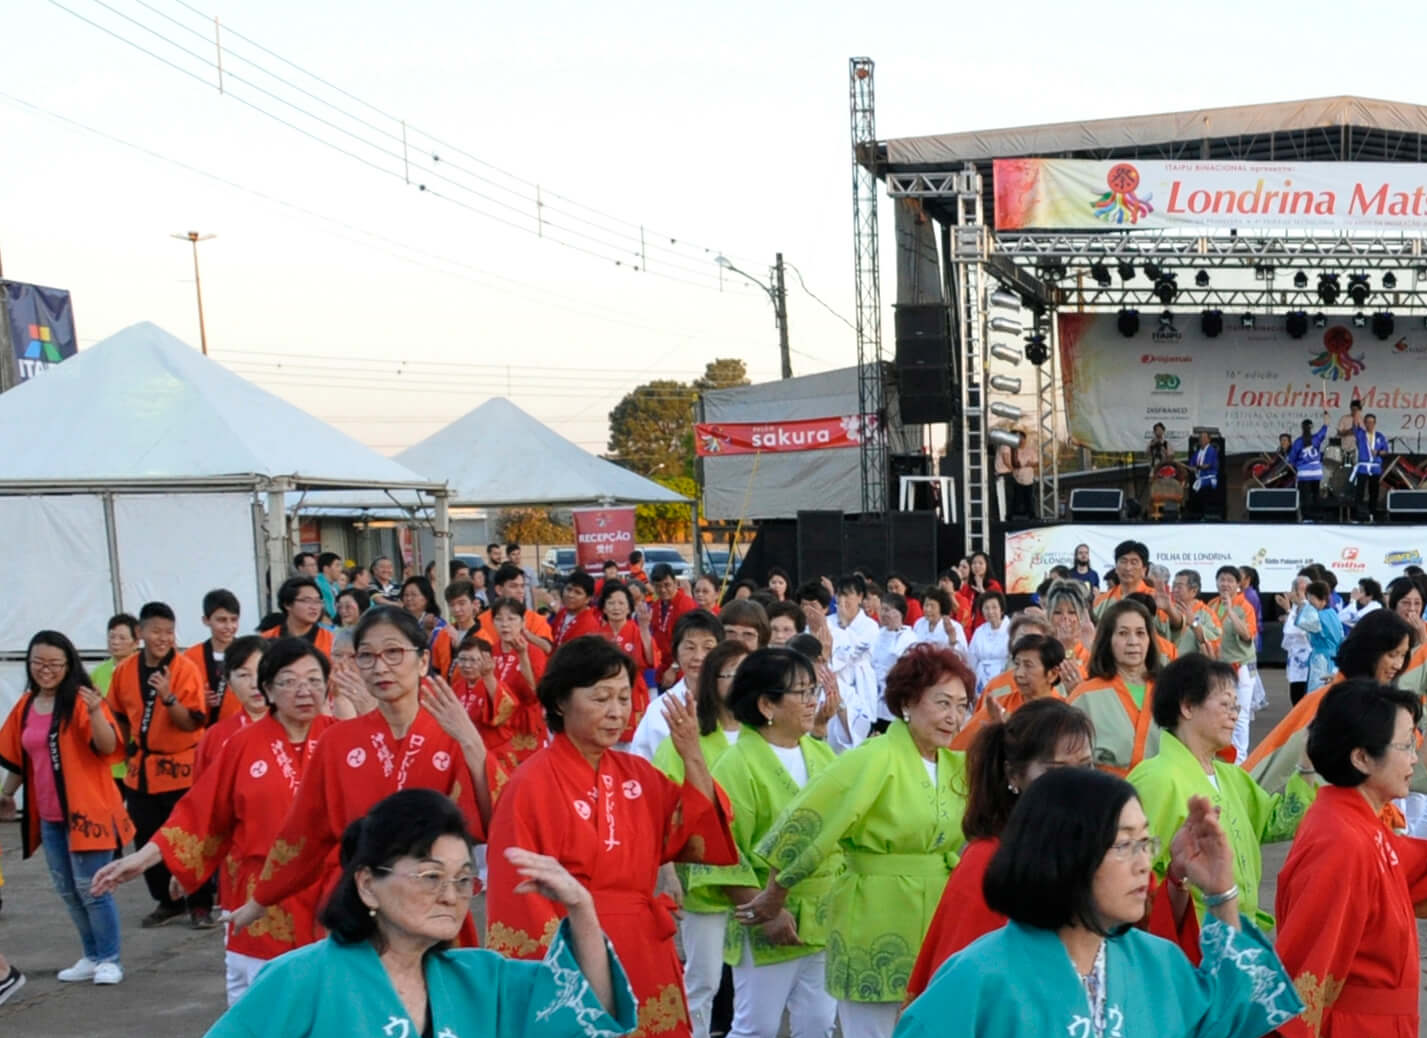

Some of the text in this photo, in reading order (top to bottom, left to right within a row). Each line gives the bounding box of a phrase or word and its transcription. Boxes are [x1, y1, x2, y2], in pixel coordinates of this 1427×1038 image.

[1166, 178, 1336, 215] Londrina
[1225, 383, 1340, 408] Londrina
[752, 427, 829, 447] sakura
[578, 530, 631, 543] RECEPÇÃO
[1156, 553, 1232, 561] FOLHA DE LONDRINA
